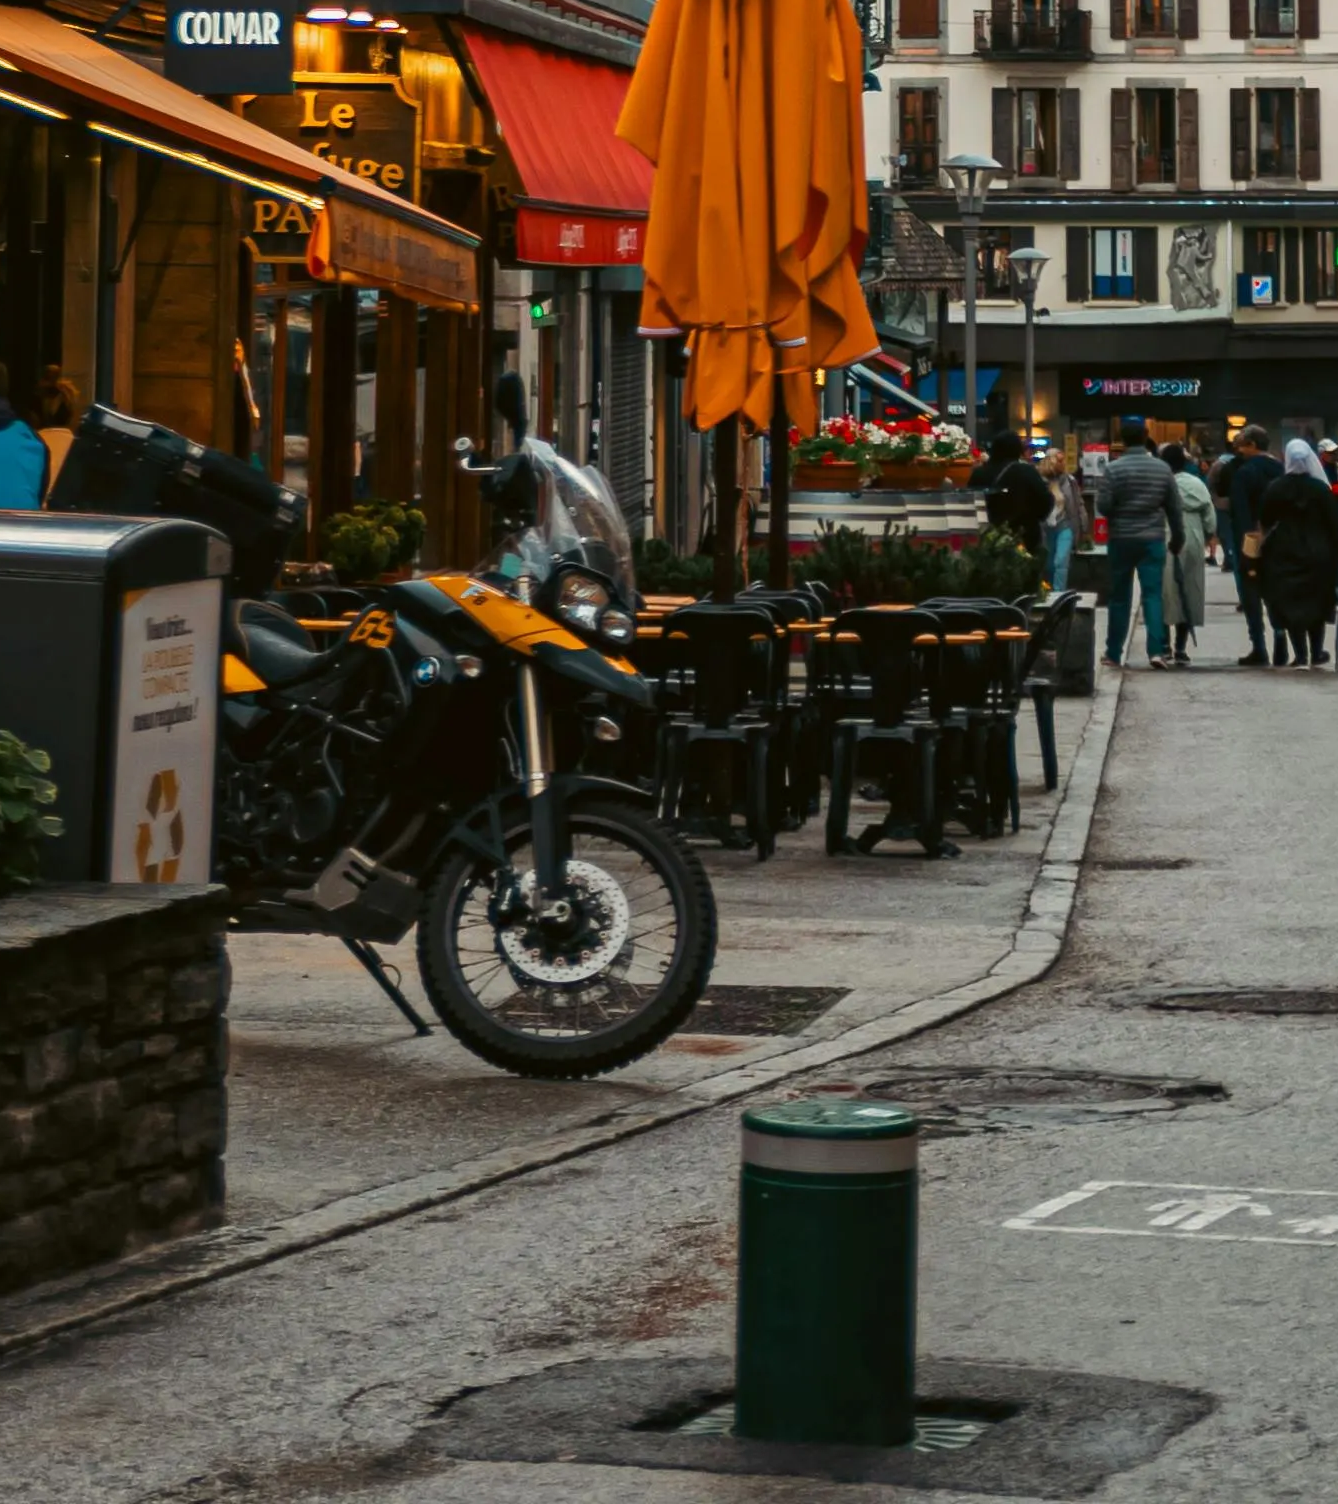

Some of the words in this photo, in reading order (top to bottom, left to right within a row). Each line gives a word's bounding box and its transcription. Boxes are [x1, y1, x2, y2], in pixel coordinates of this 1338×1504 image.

[177, 10, 281, 45] COLMAR
[299, 90, 357, 128] Le
[1102, 377, 1201, 396] INTERSPORT
[348, 610, 395, 649] GS
